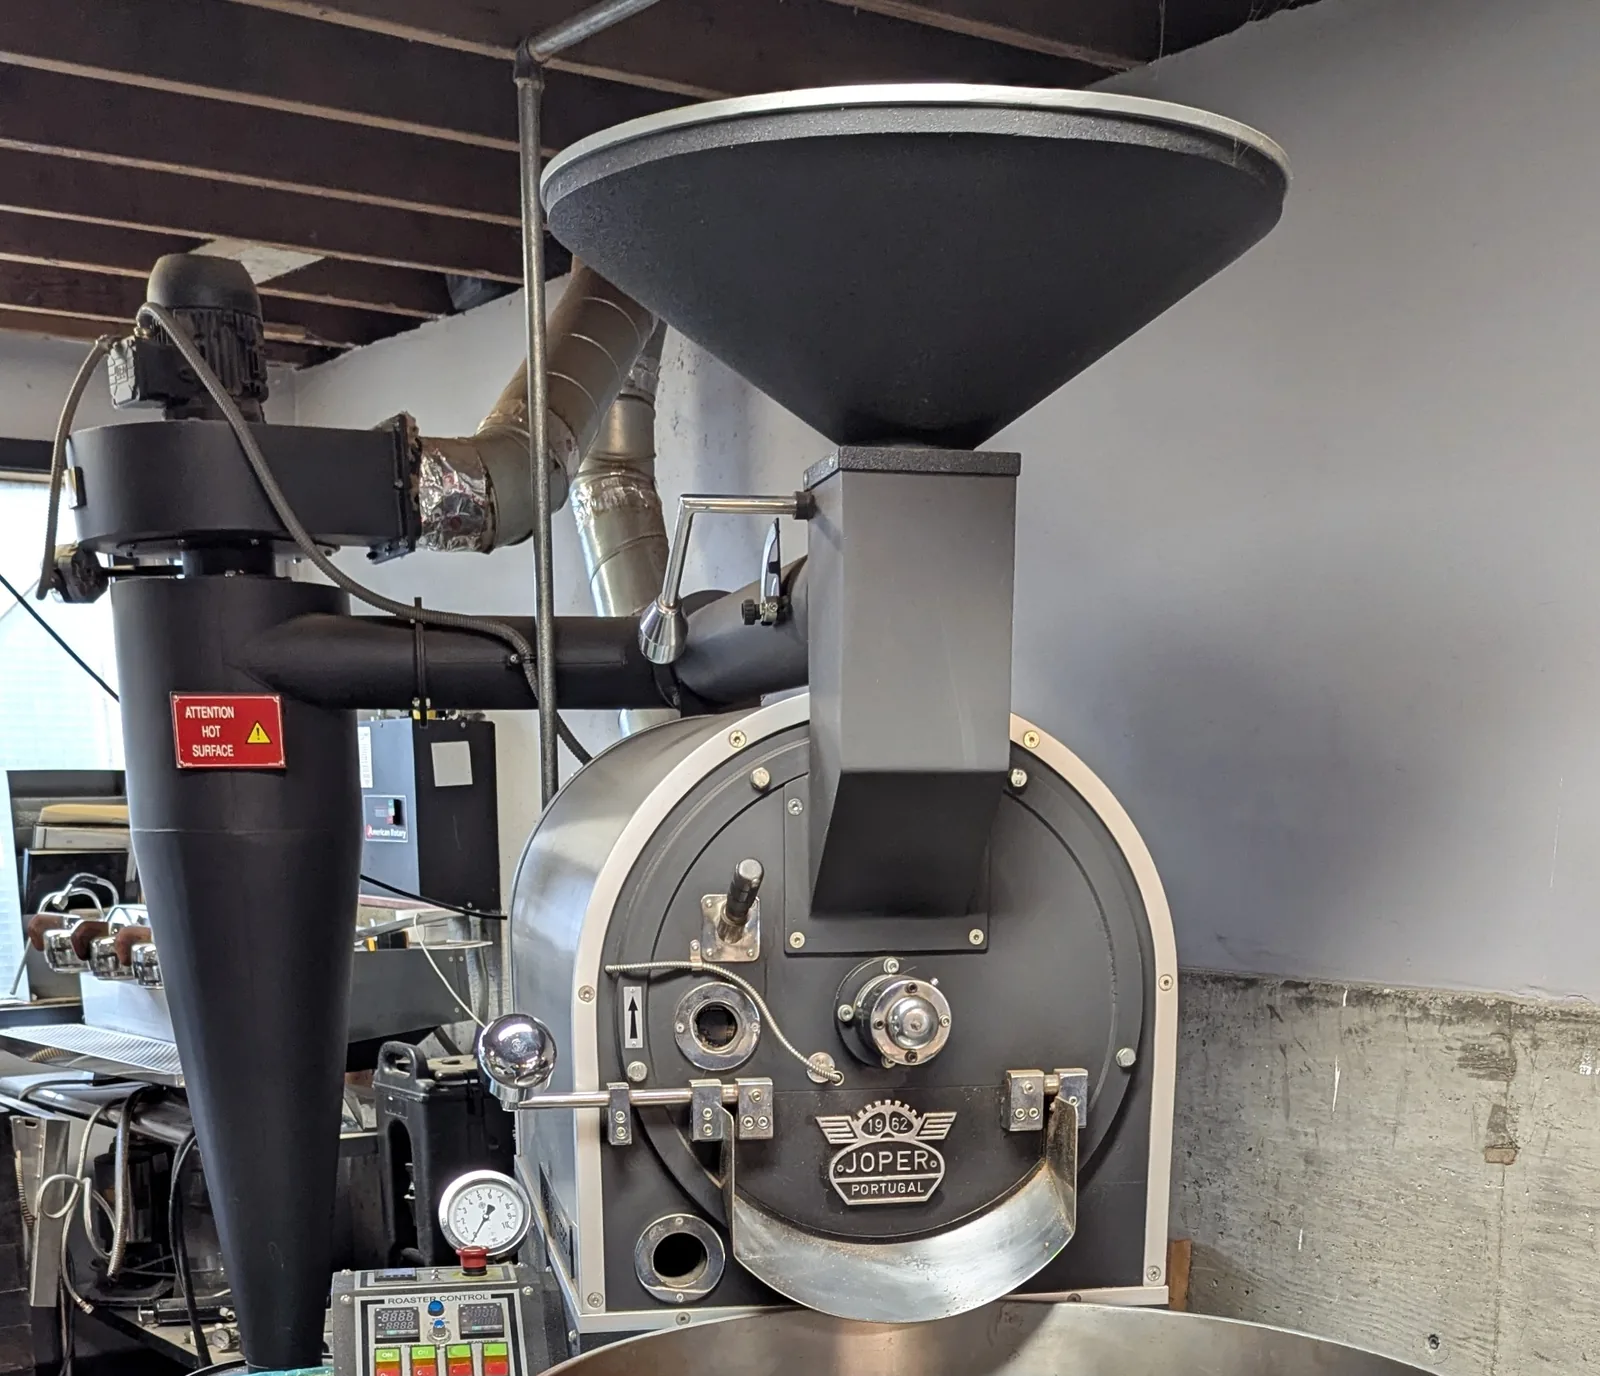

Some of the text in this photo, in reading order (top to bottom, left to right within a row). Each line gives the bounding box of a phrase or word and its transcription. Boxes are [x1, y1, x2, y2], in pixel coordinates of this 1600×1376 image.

[185, 706, 235, 719] ATTENTION
[201, 725, 221, 738] HOT
[192, 744, 234, 757] SURFACE
[368, 825, 406, 839] American Rotary
[845, 1150, 929, 1174] JOPER
[851, 1181, 925, 1196] PORTUGAL
[387, 1294, 489, 1305] ROASTER CONTROL
